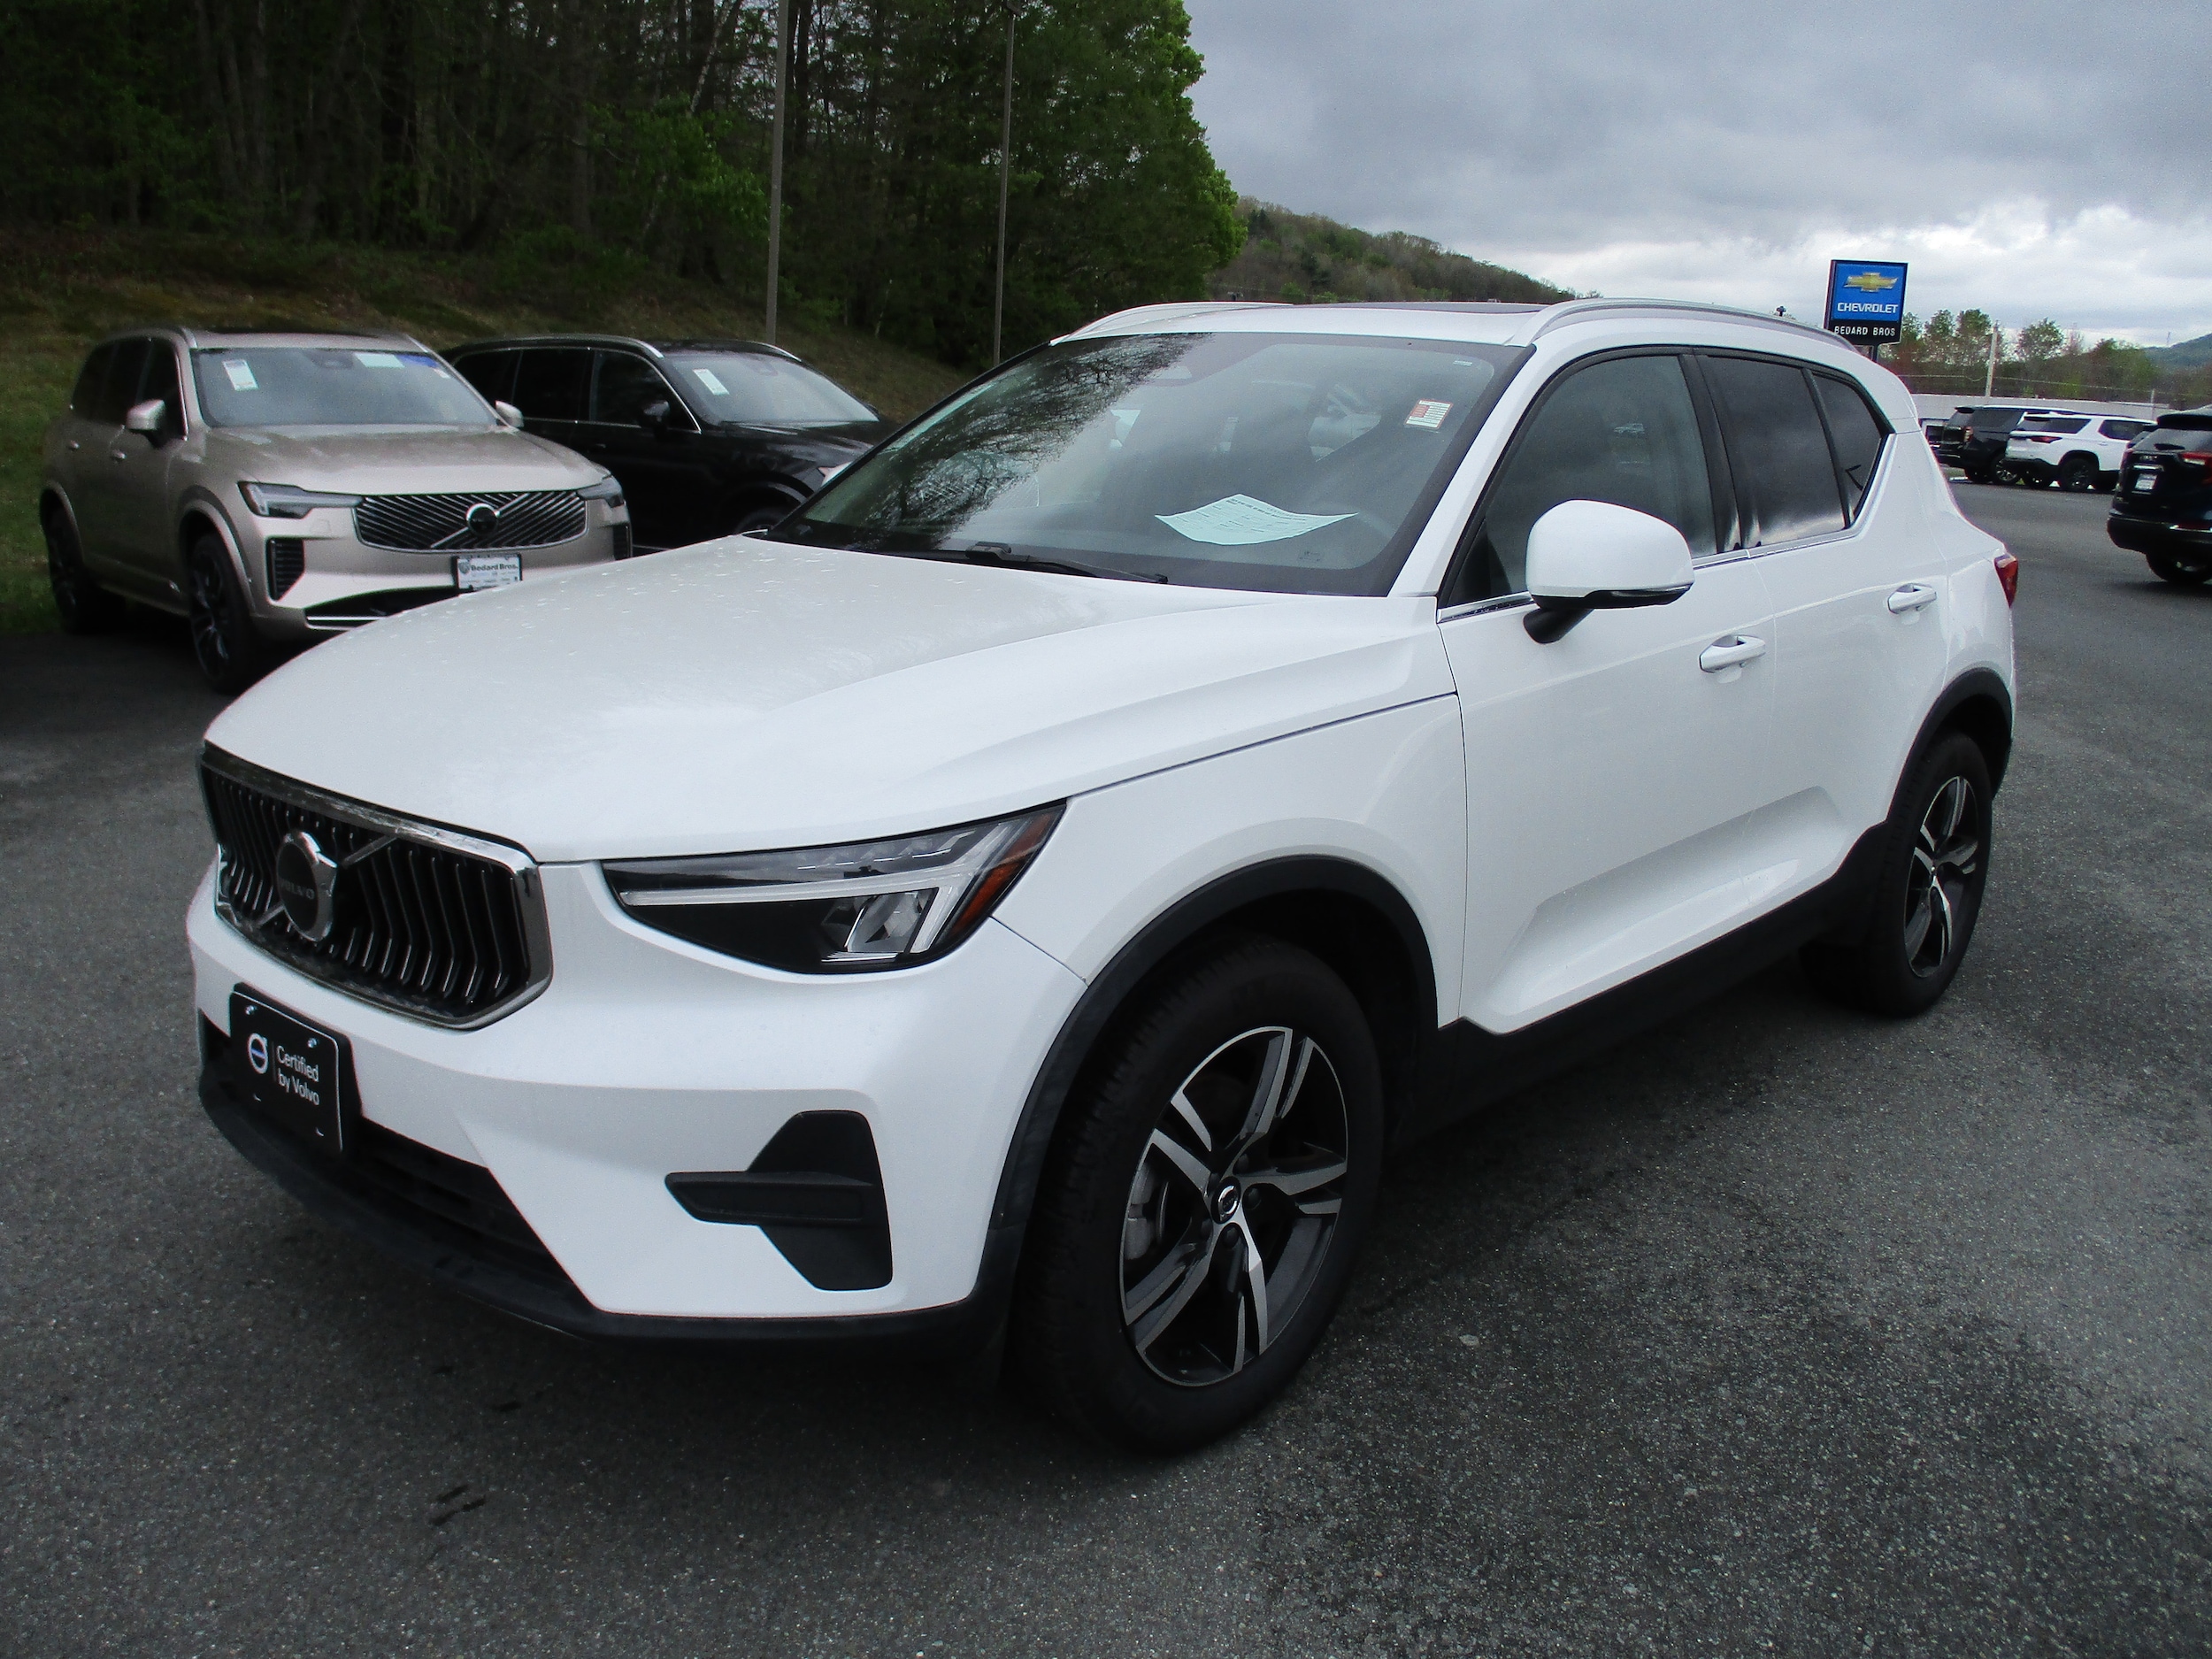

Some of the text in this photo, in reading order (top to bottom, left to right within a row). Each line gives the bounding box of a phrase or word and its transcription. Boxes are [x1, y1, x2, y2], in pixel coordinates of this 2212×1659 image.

[1837, 302, 1898, 313] CHEVROLET
[1834, 326, 1895, 336] BEDARD BROS
[277, 1045, 319, 1082] Certified
[277, 1068, 319, 1106] by Volvo
